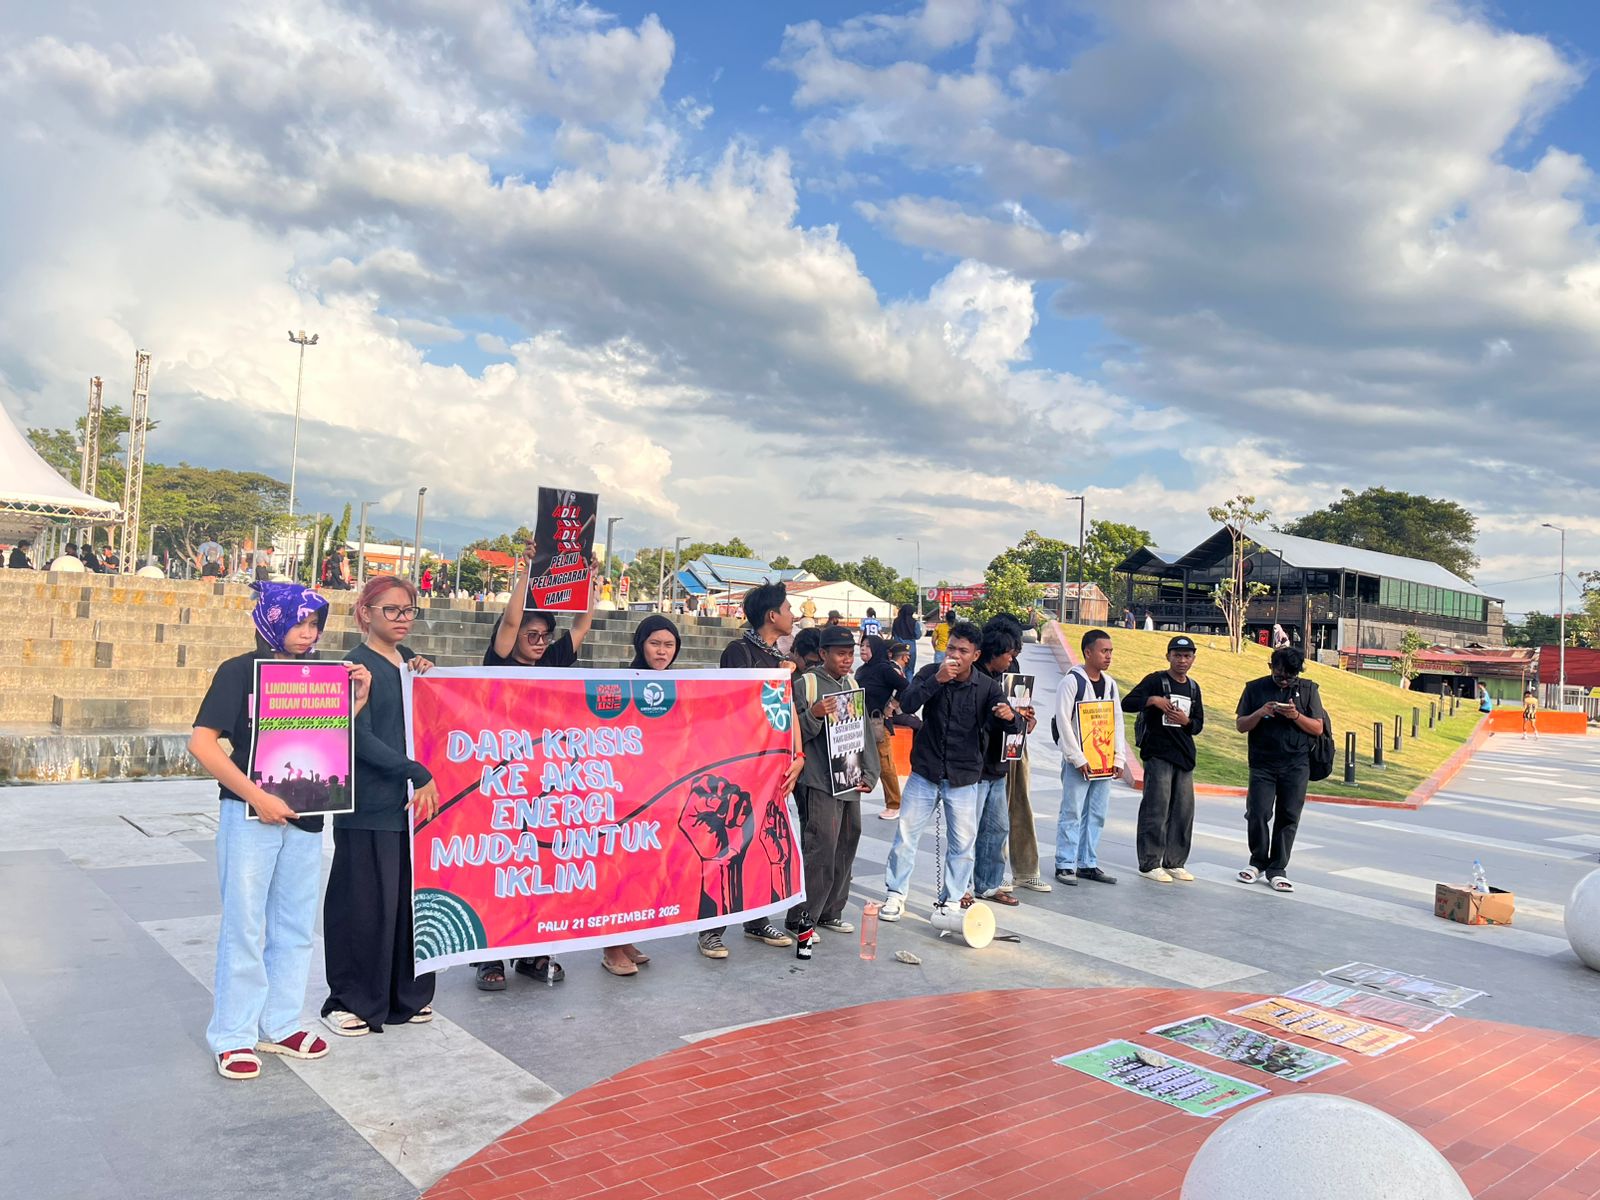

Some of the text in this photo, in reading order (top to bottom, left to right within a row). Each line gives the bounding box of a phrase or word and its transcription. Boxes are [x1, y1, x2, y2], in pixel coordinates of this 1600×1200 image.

[550, 552, 580, 569] PELAKU
[531, 568, 588, 590] PELANGGARAN
[866, 624, 878, 636] 19
[265, 682, 307, 695] LINDUNGI
[269, 697, 340, 710] BUKAN OLIGARKI
[447, 725, 644, 763] DARI KRISIS
[480, 759, 624, 797] KE AKSI,
[490, 791, 615, 830] ENERGI
[430, 820, 662, 871] MUDA UNTUK
[494, 861, 597, 899] IKLIM
[537, 904, 681, 933] PALU 21 SEPTEMBER 2025
